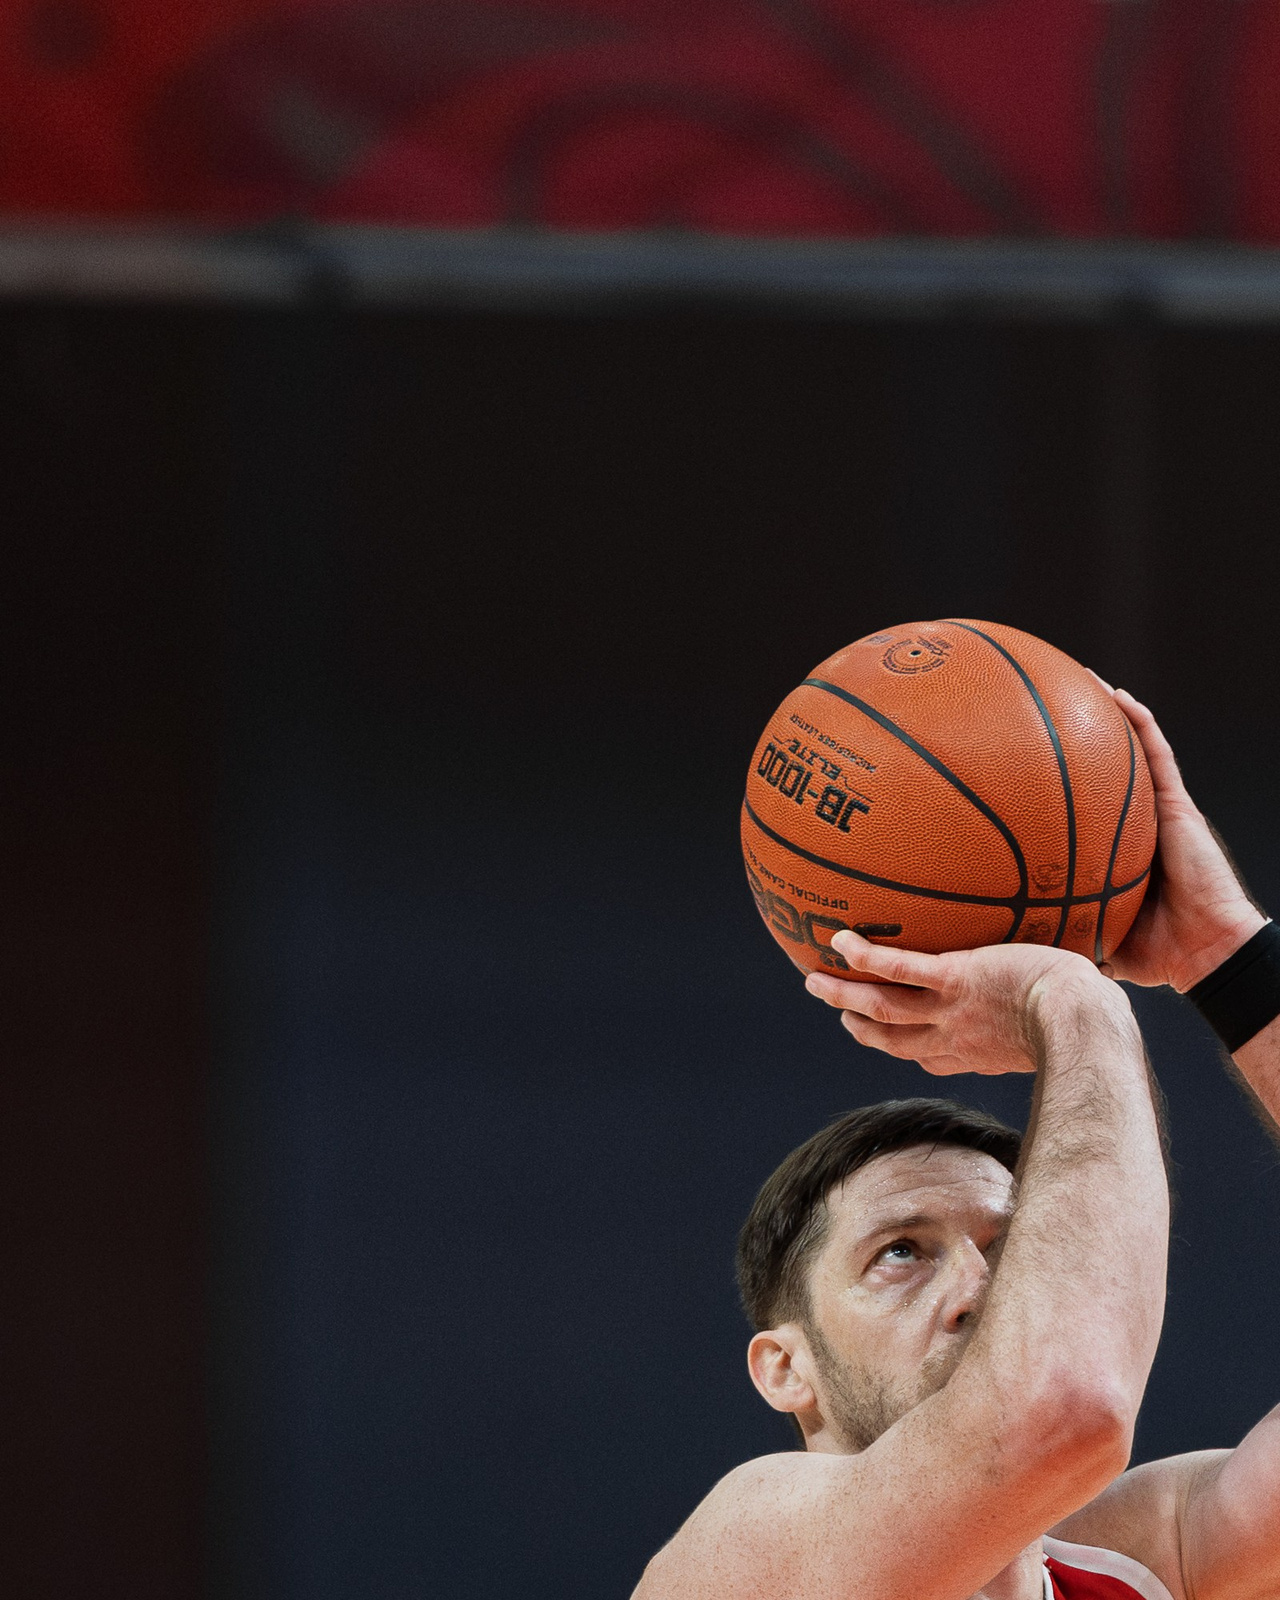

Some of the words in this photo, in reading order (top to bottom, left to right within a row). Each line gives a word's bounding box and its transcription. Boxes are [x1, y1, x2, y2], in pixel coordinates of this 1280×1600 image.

[788, 738, 842, 780] ELITE
[757, 742, 871, 833] JB-1000
[790, 883, 849, 911] OFFICIAL
